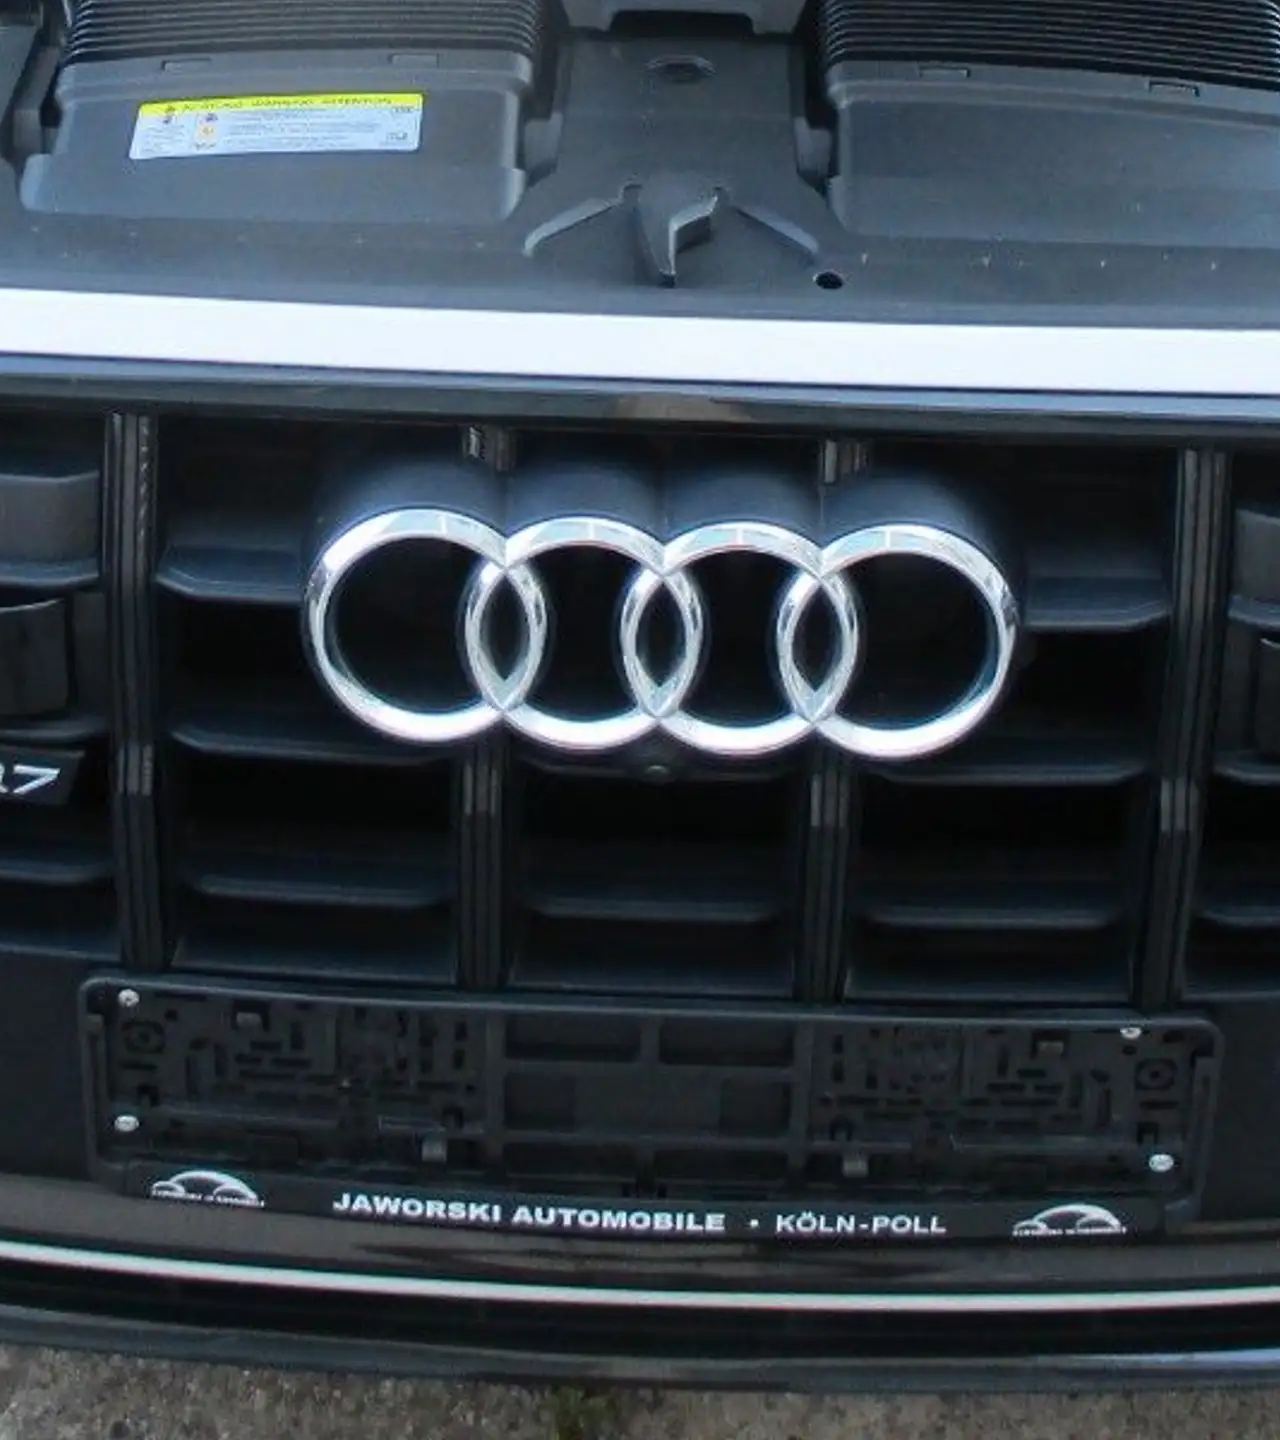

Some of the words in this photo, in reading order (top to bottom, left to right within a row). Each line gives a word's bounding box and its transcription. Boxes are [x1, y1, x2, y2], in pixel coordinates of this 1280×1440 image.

[332, 1193, 501, 1224] JAWORSKI
[511, 1204, 726, 1232] AUTOMOBILE
[775, 1211, 947, 1234] KÖLN-POLL
